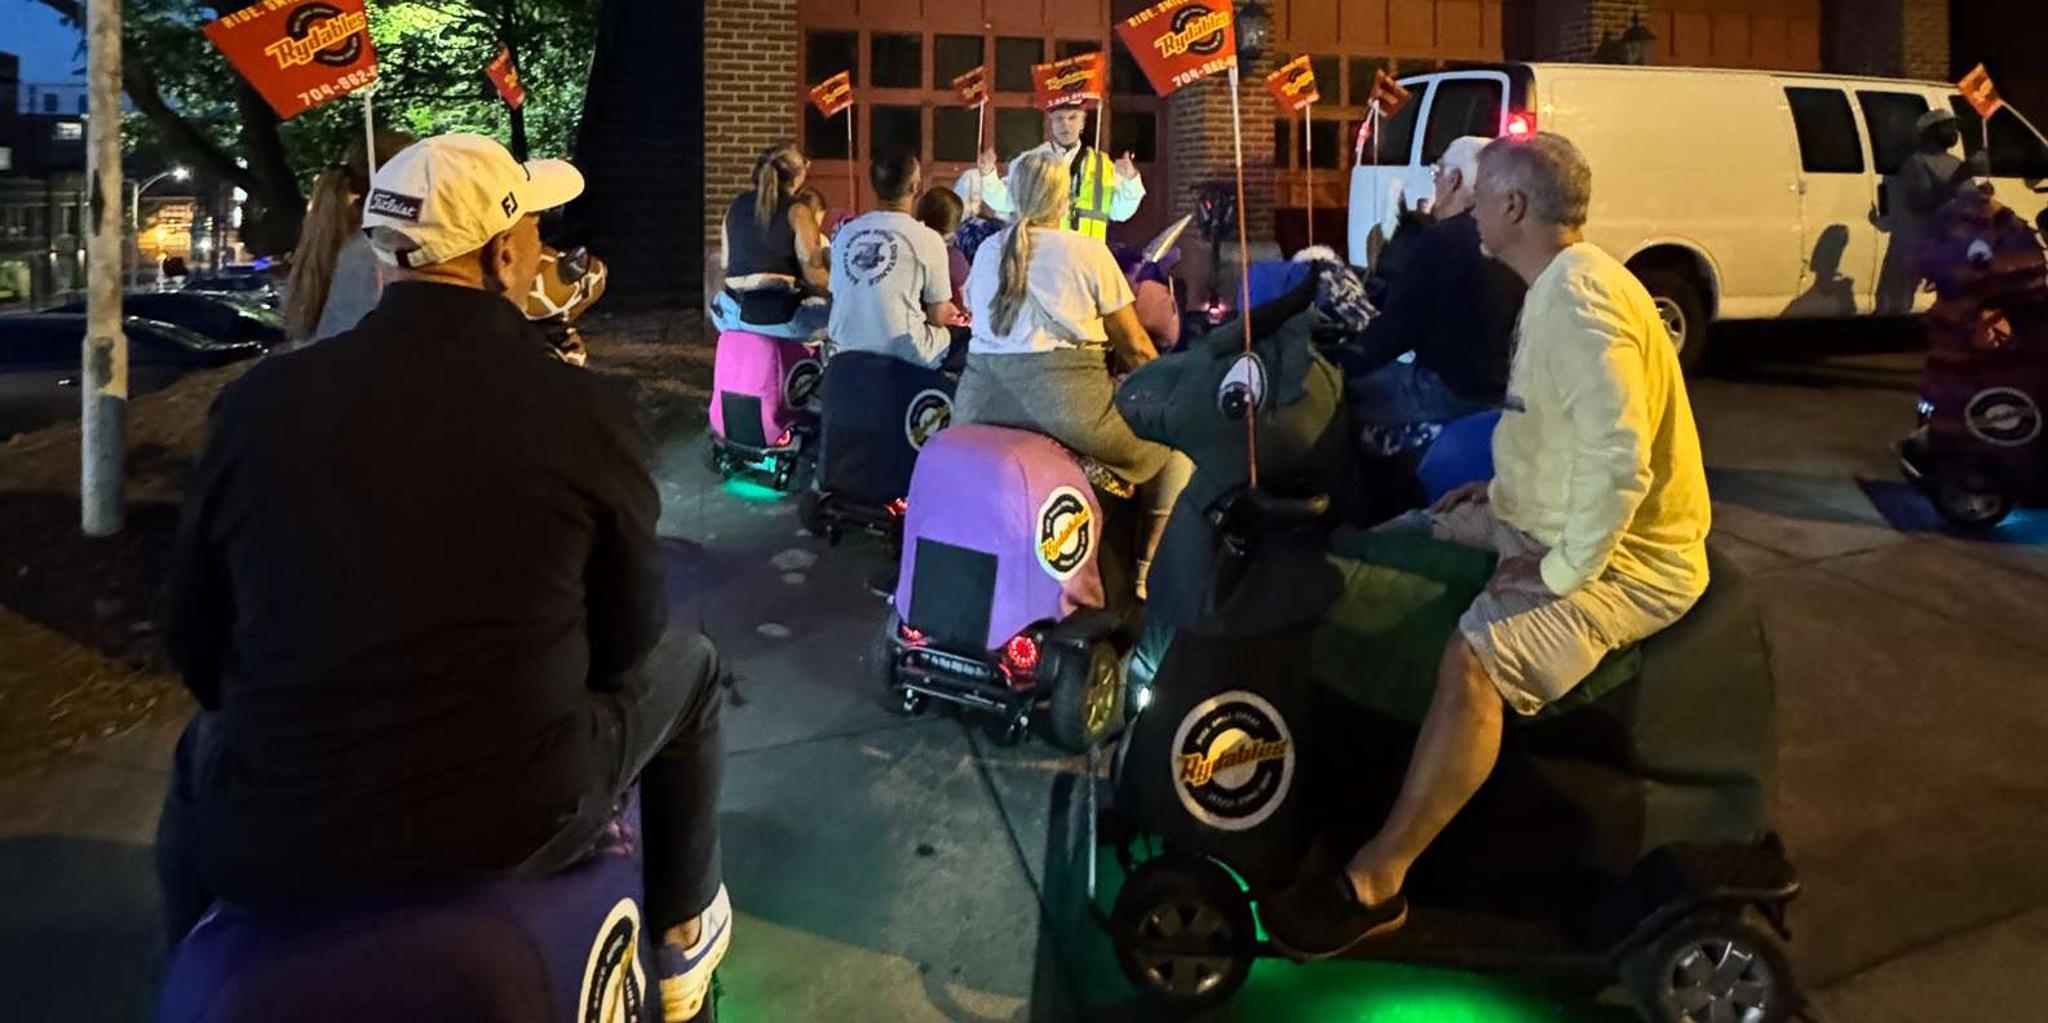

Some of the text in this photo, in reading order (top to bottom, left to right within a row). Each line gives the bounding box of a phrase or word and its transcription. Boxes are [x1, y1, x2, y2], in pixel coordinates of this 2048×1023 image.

[265, 11, 367, 70] Rydables
[1153, 11, 1231, 58] Rydables
[501, 191, 519, 219] FJ
[1176, 738, 1289, 788] Rydables
